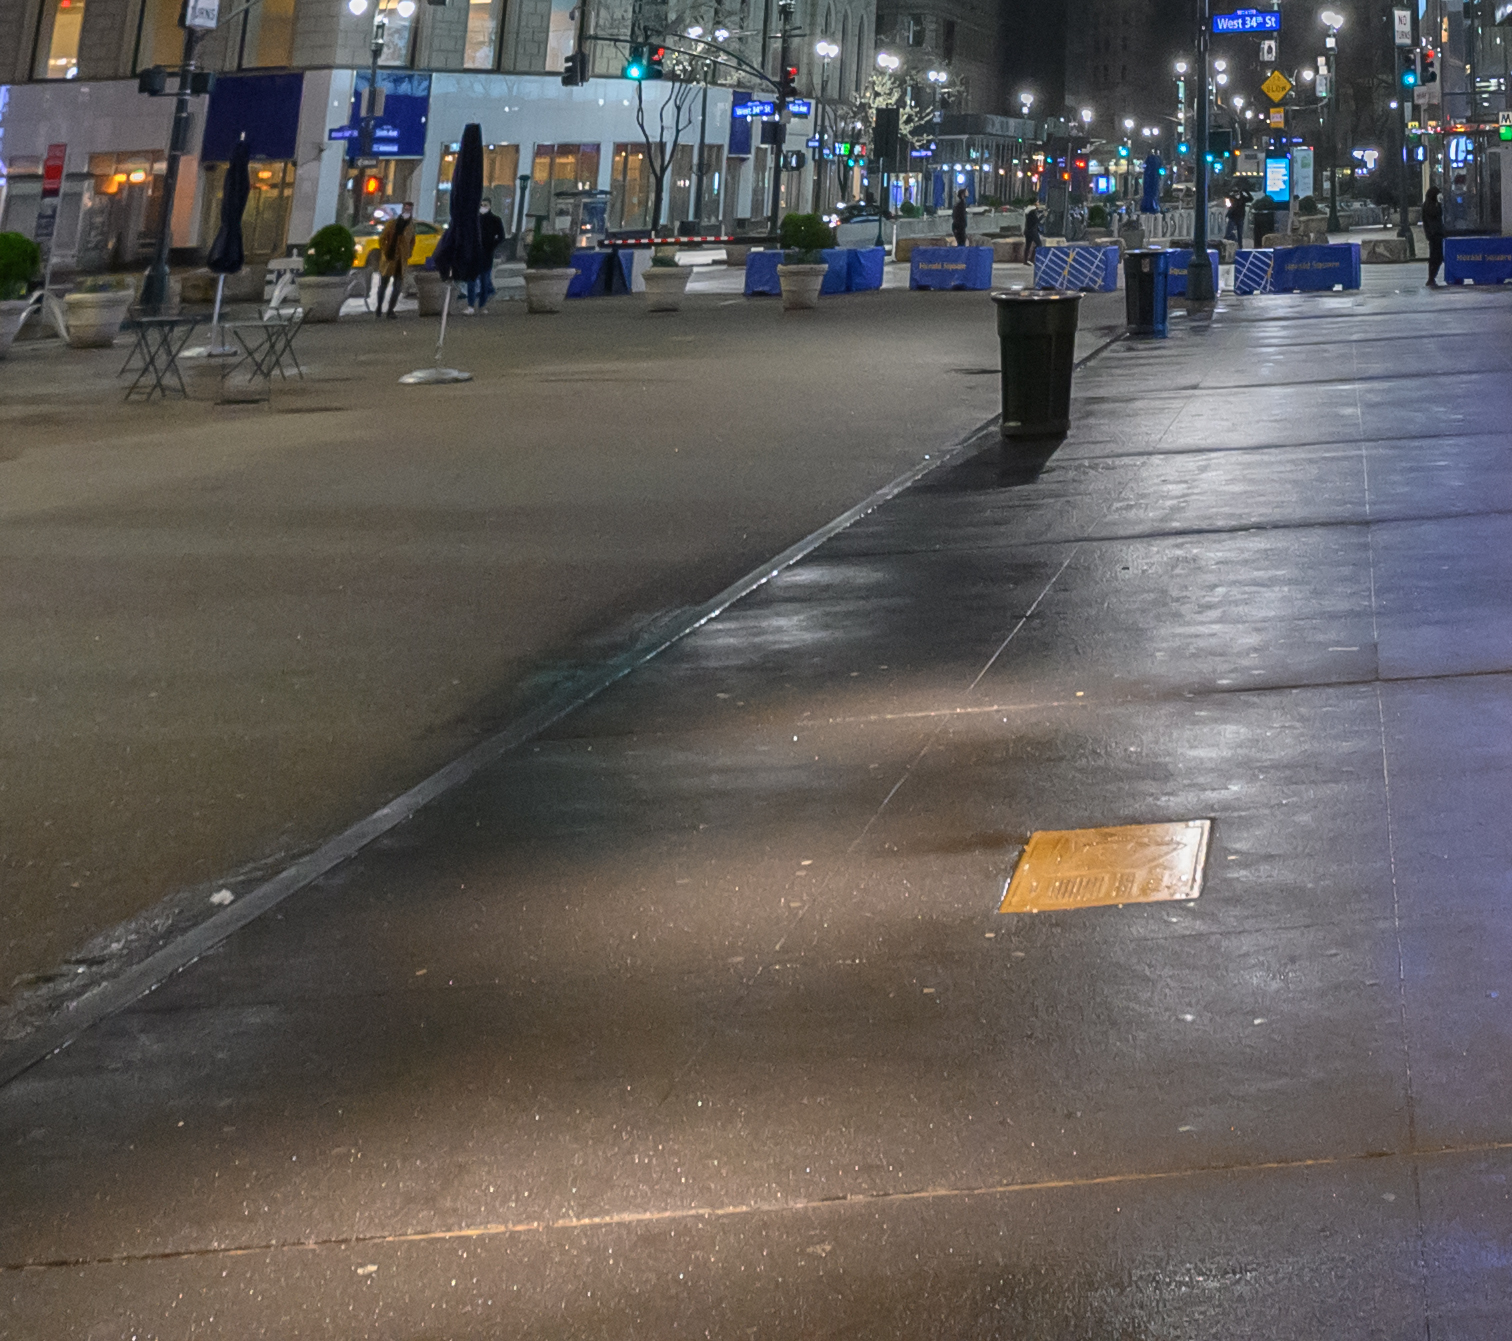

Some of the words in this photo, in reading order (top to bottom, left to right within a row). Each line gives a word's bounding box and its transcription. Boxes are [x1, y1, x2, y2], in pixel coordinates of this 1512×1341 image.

[1217, 18, 1243, 29] West
[1245, 16, 1264, 28] 34th
[1265, 16, 1276, 27] St
[1169, 266, 1188, 276] Squa
